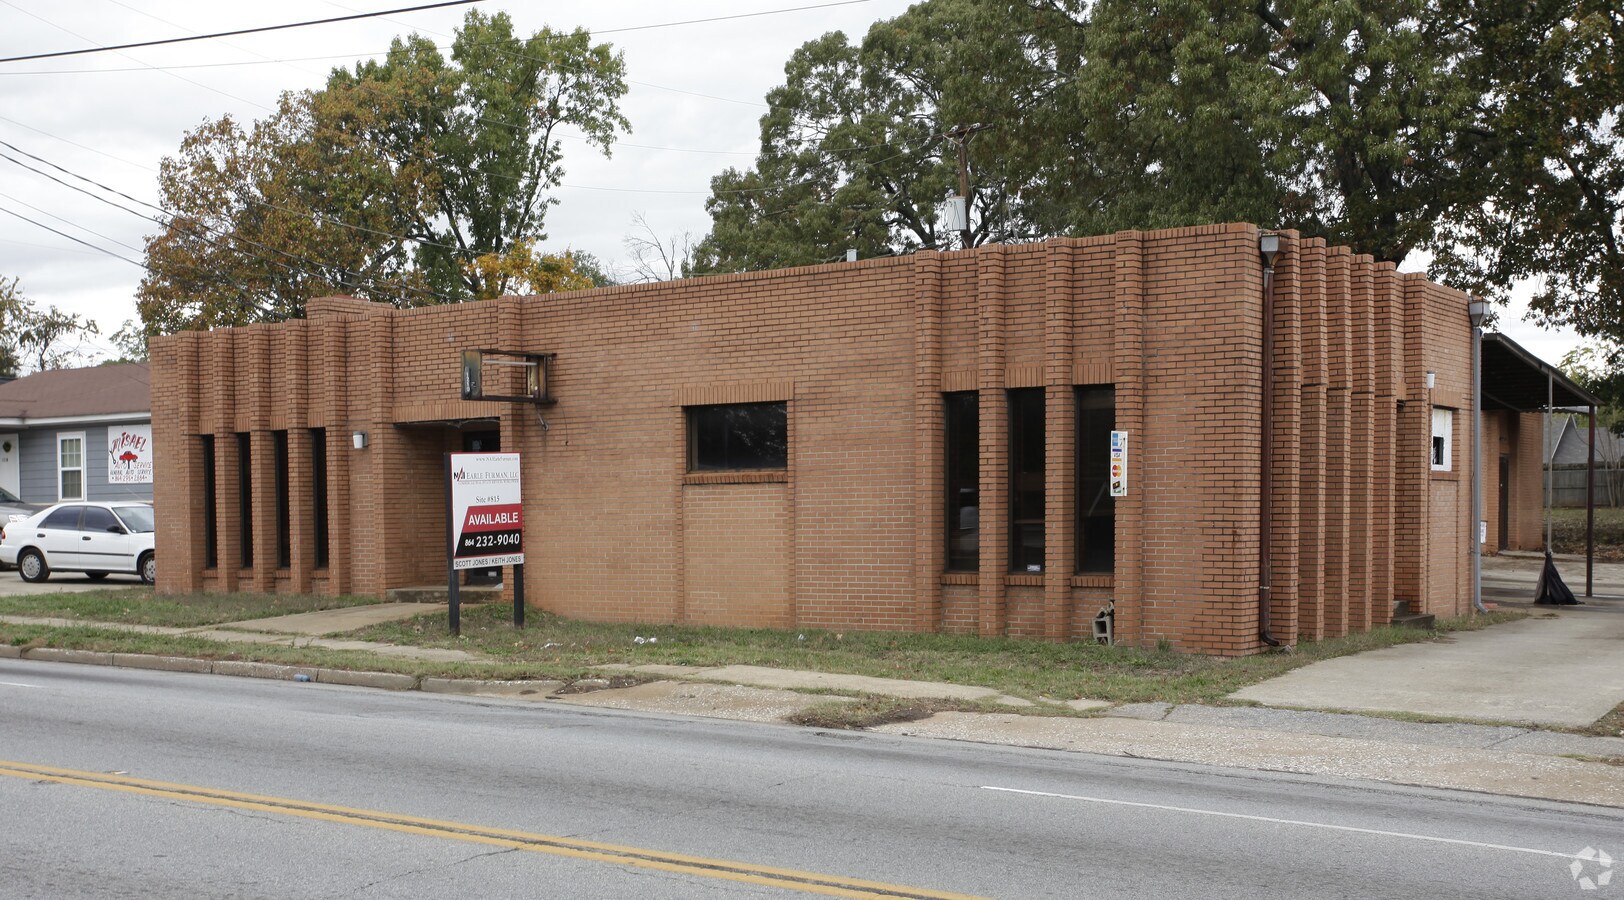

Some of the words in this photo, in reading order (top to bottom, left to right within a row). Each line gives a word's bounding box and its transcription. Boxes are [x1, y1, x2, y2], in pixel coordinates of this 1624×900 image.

[475, 496, 486, 504] Site
[468, 512, 519, 526] AVAILABLE
[464, 538, 475, 547] 864
[476, 533, 520, 547] 232-9040
[455, 560, 472, 568] SCOTT
